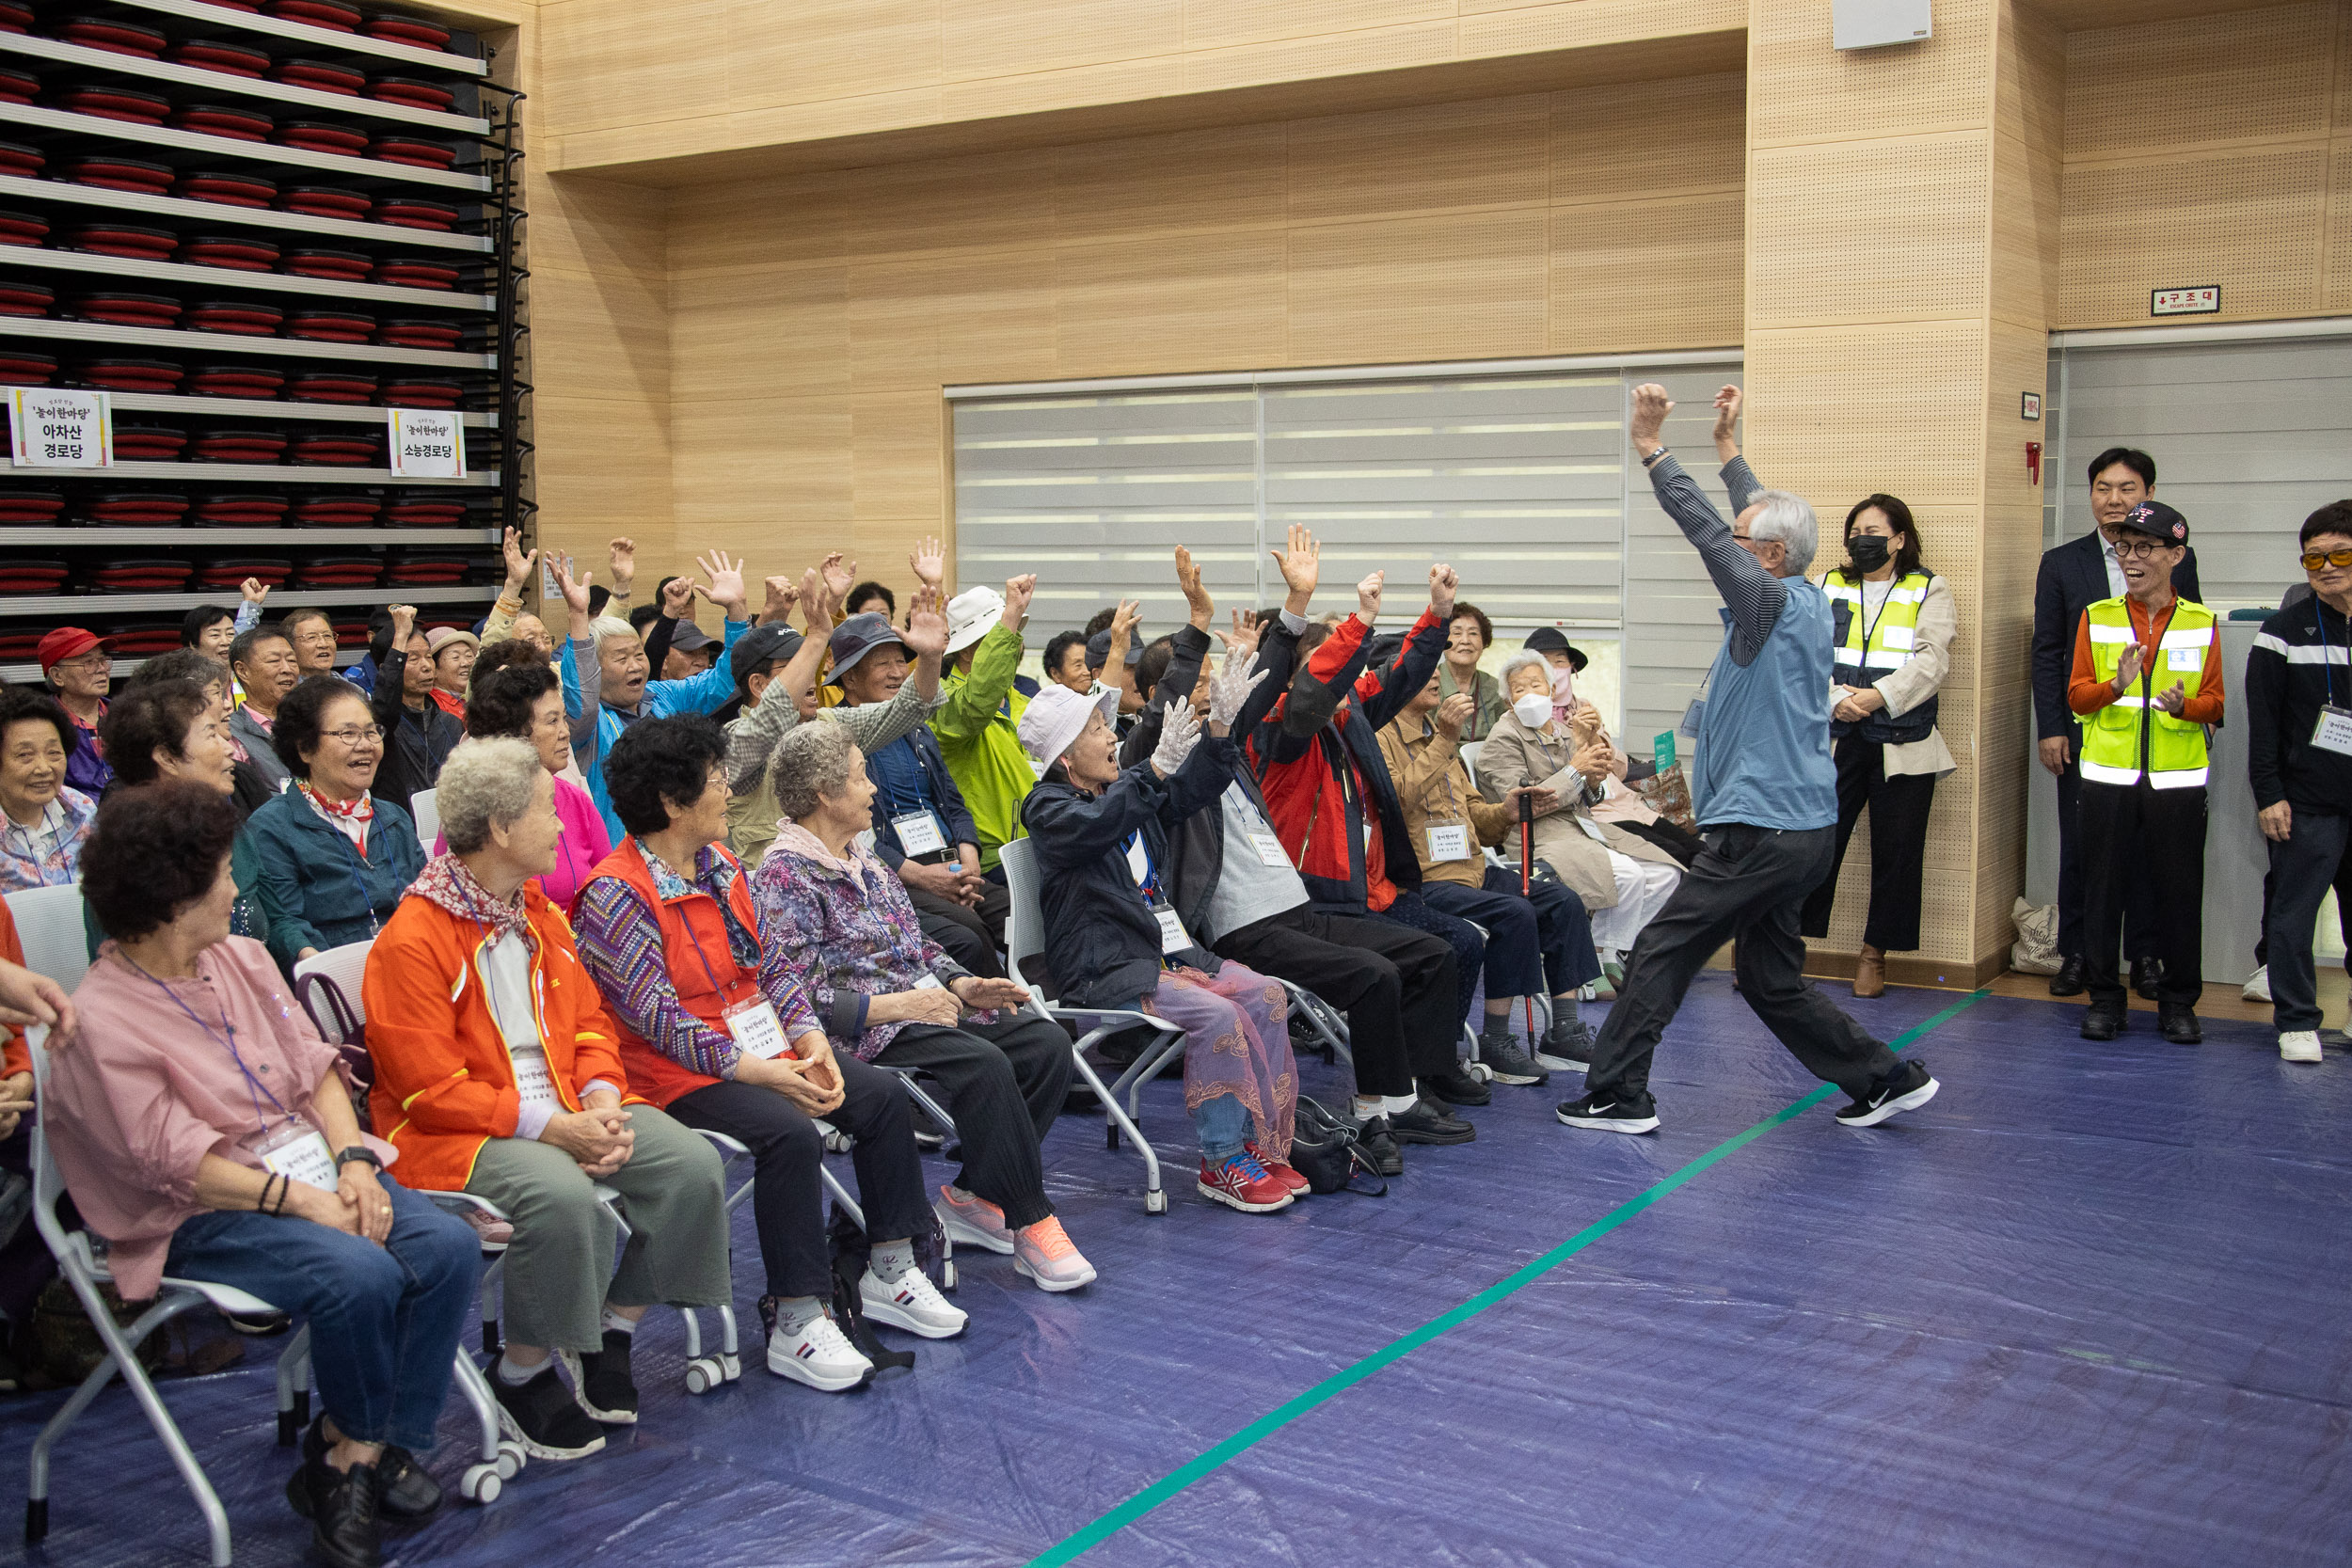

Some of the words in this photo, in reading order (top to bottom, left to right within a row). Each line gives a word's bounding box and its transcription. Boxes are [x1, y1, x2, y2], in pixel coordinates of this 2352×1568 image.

[33, 406, 90, 420] '놀이한마당'
[43, 424, 82, 440] 아차산
[406, 424, 449, 436] '놀이한마당'
[44, 443, 83, 459] 경로당
[405, 444, 452, 458] 소능경로당
